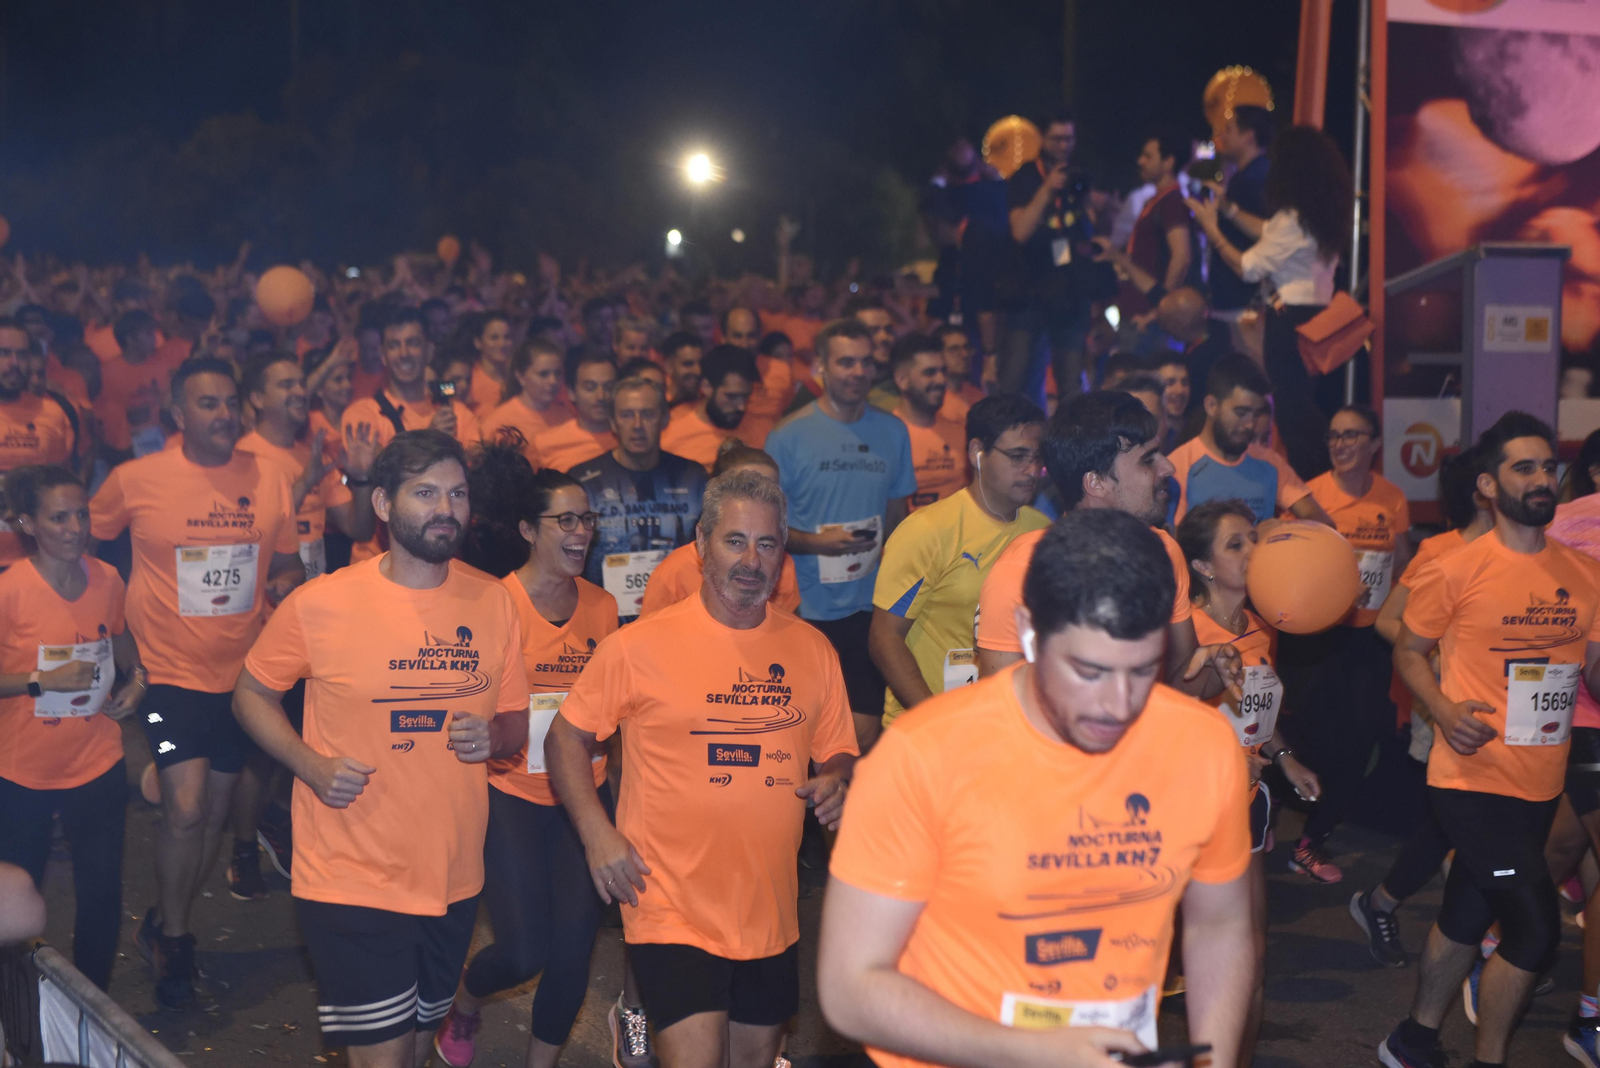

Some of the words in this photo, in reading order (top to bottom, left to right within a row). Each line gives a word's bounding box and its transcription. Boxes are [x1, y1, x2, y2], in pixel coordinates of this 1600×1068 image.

[208, 512, 255, 520] NOCTURNA
[187, 519, 230, 528] SEVILLA
[202, 568, 241, 587] 4275
[1526, 607, 1577, 615] NOCTURNA
[1501, 616, 1549, 626] SEVILLA
[418, 648, 480, 660] NOCTURNA
[388, 660, 448, 671] SEVILLA
[535, 663, 577, 673] SEVILLA
[732, 684, 792, 695] NOCTURNA
[706, 693, 759, 706] SEVILLA
[1531, 691, 1575, 712] 15694
[1068, 830, 1163, 848] NOCTURNA
[1028, 851, 1111, 869] SEVILLA
